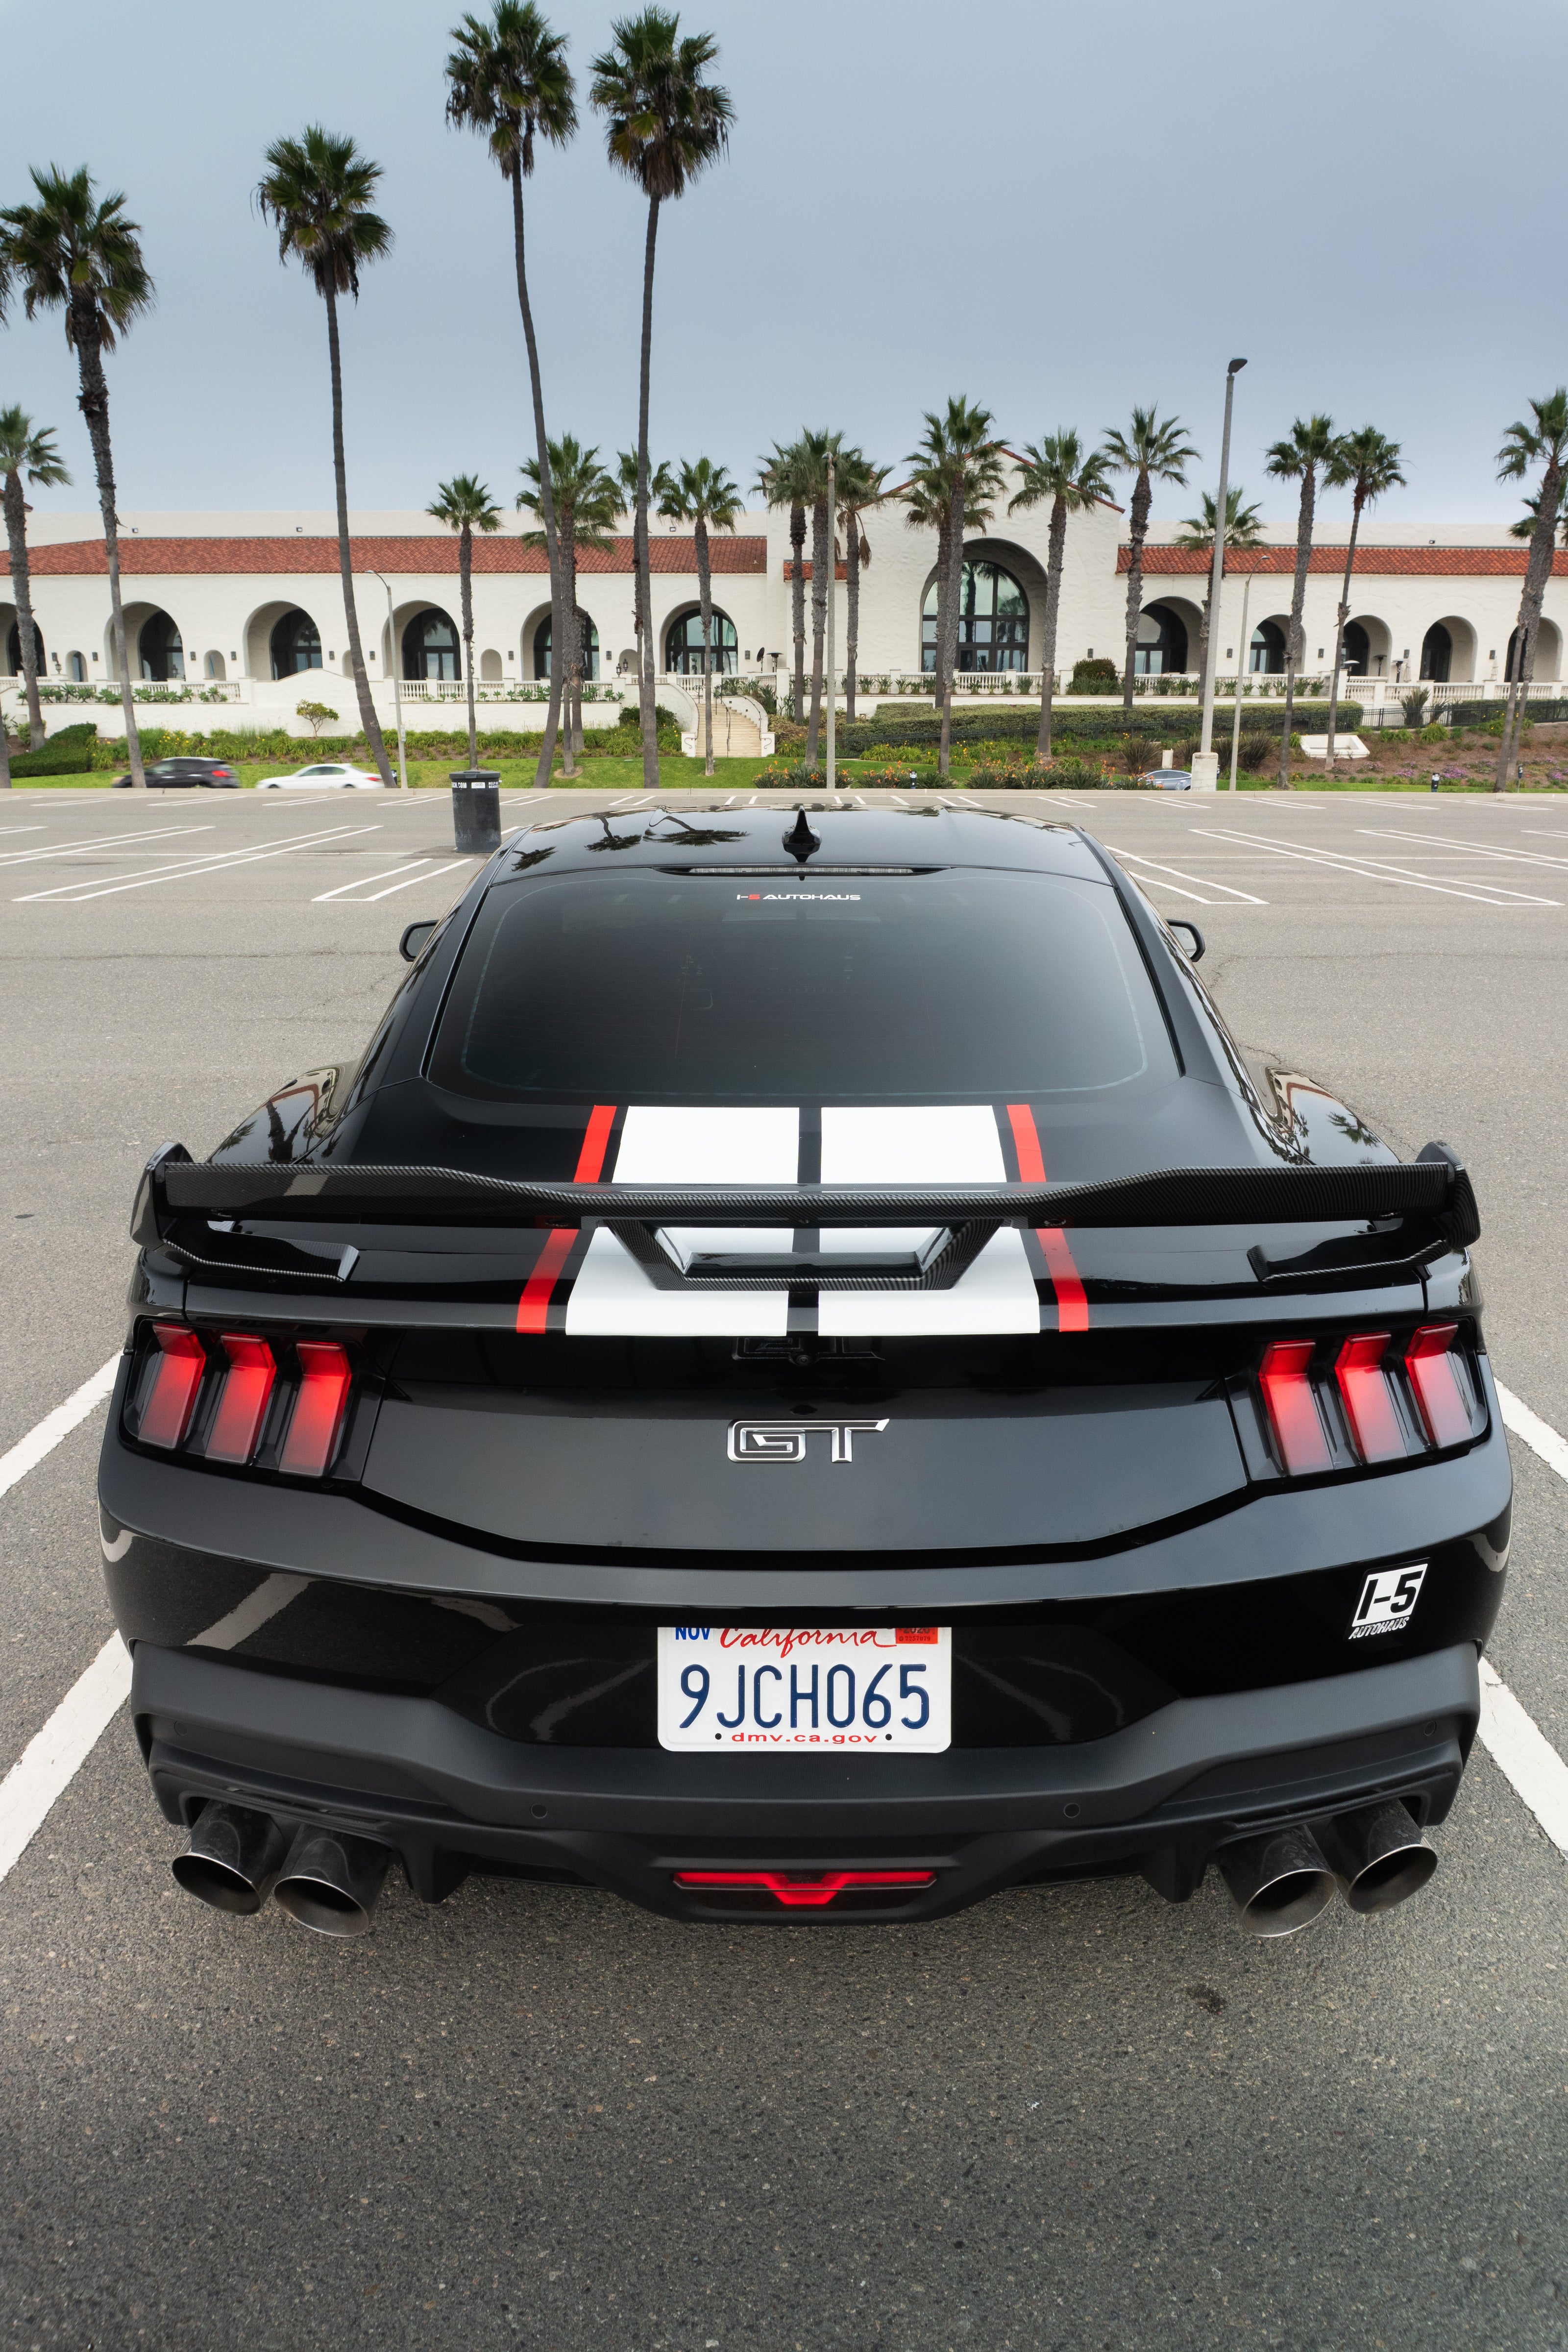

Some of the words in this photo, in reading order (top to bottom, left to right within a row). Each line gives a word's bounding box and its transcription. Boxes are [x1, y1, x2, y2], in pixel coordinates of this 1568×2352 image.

[727, 1419, 889, 1463] GT
[1357, 1570, 1423, 1621] I-5
[676, 1627, 710, 1640] NOV
[720, 1628, 897, 1658] California
[1348, 1617, 1410, 1640] AUTOHAUS
[679, 1664, 930, 1729] 9JCH065
[732, 1733, 877, 1744] dmv.ca.gov
